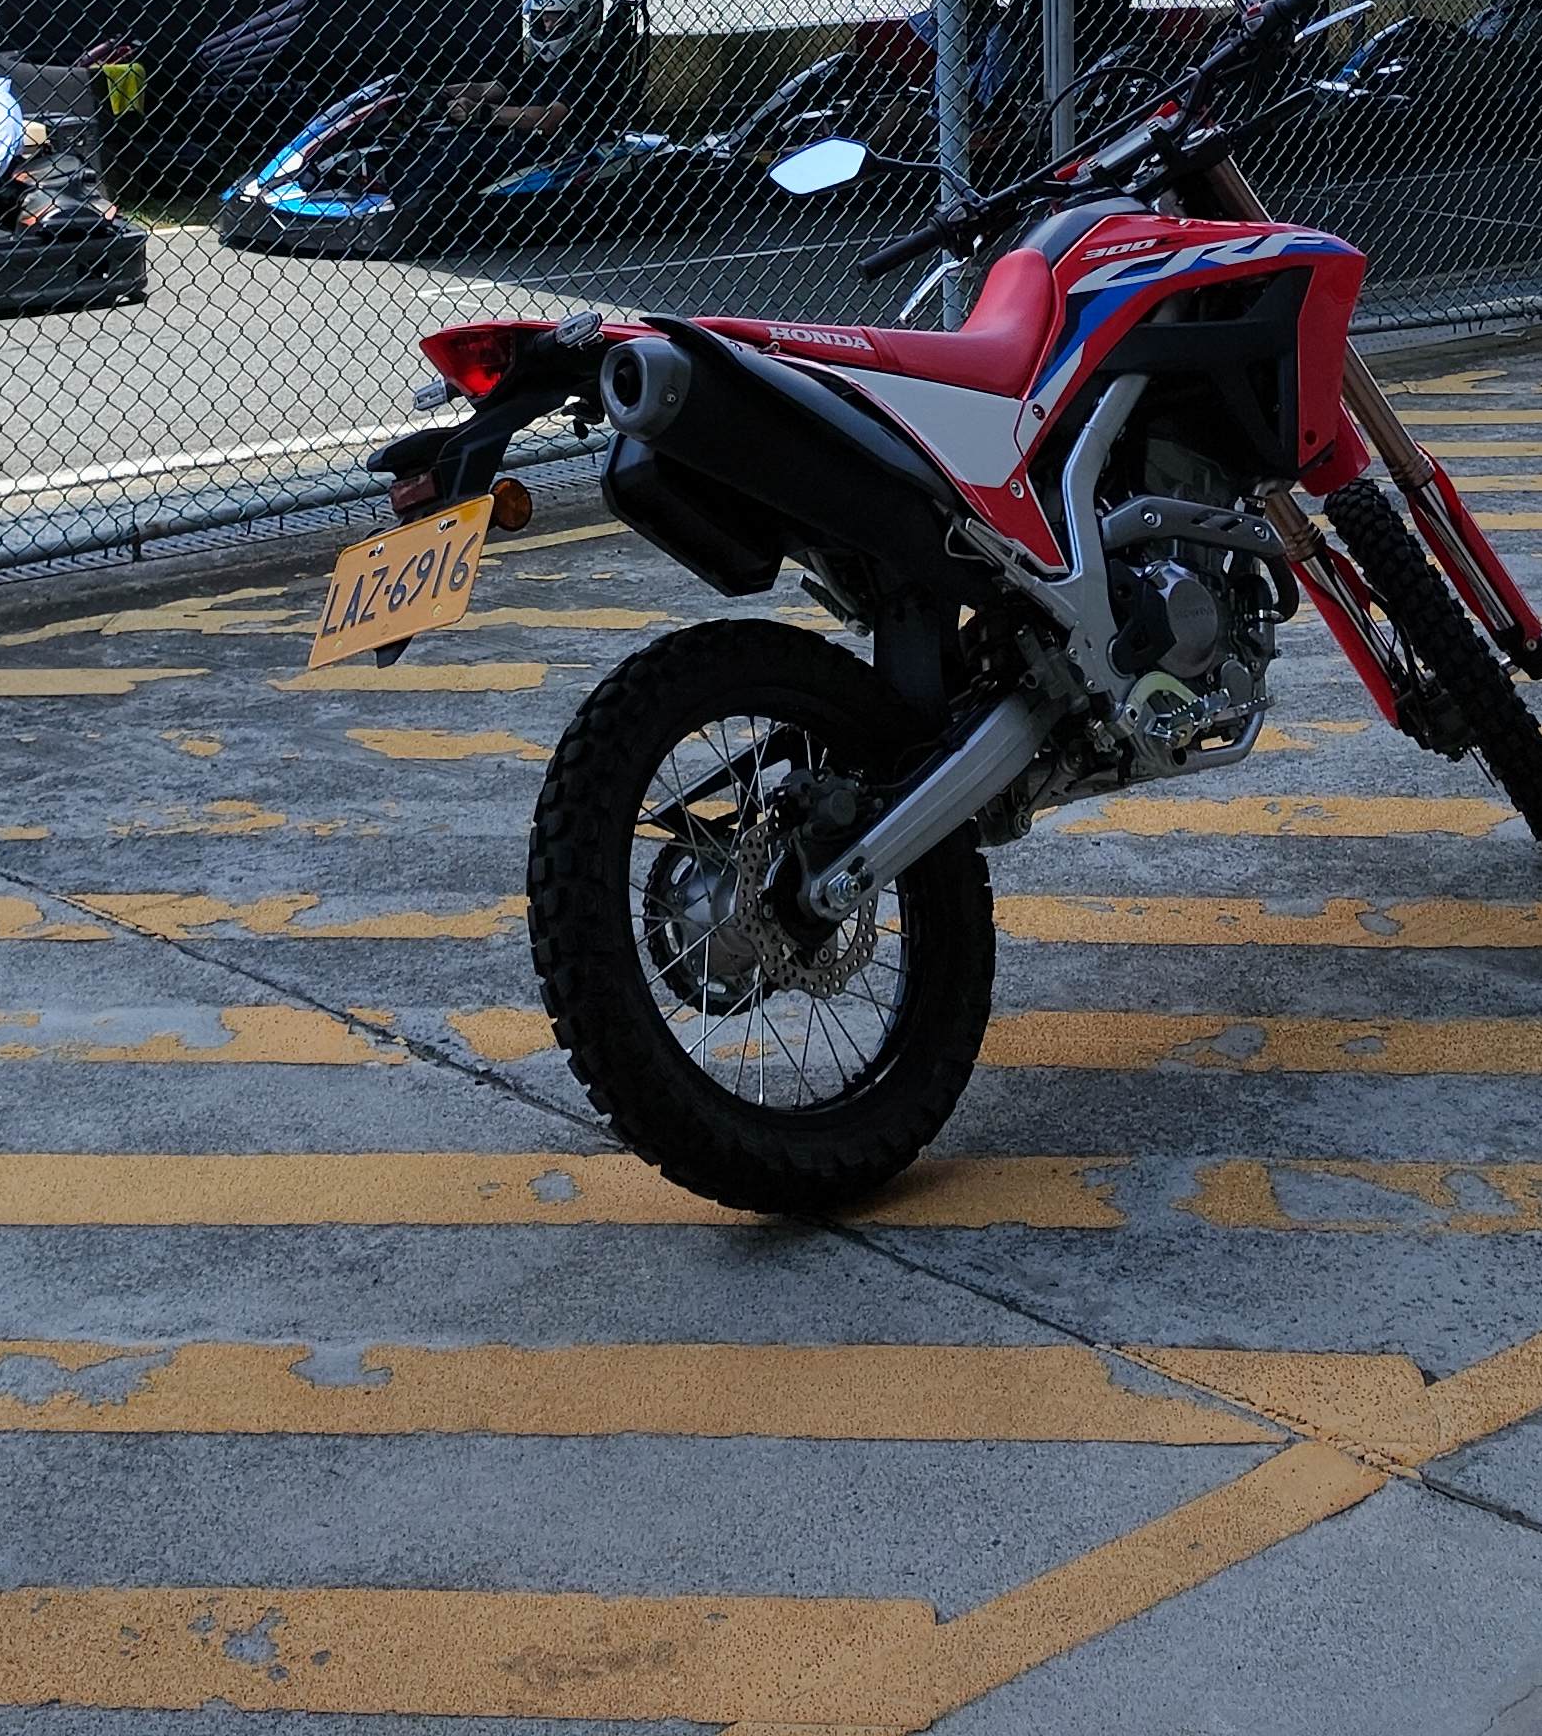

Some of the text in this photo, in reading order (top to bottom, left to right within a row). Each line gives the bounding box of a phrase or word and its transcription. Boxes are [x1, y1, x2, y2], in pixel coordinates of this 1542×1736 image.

[1067, 232, 1335, 294] CRF
[766, 326, 875, 351] HONDA
[321, 531, 479, 639] LAZ-6916
